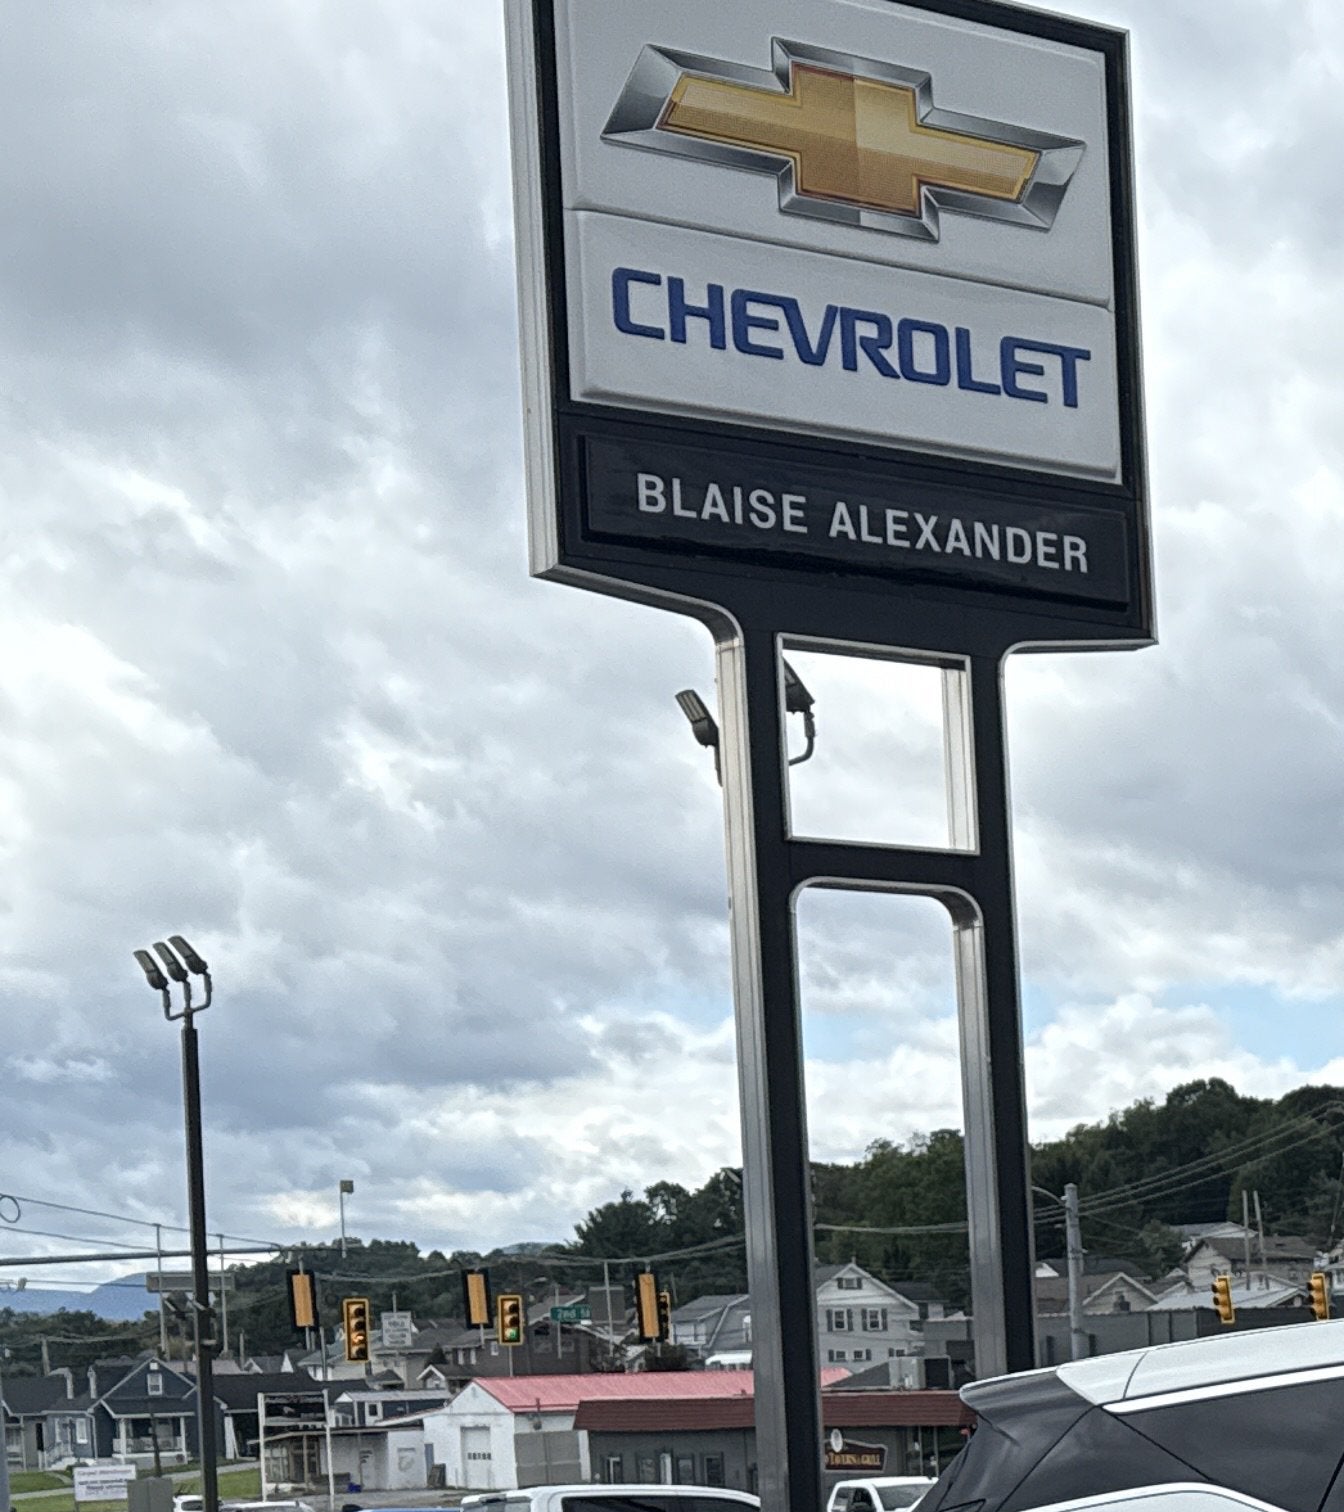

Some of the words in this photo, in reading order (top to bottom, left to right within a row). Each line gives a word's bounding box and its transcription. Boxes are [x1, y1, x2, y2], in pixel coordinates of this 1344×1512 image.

[611, 266, 1091, 409] CHEVROLET
[635, 472, 807, 534] BLAISE
[829, 500, 1088, 574] ALEXANDER
